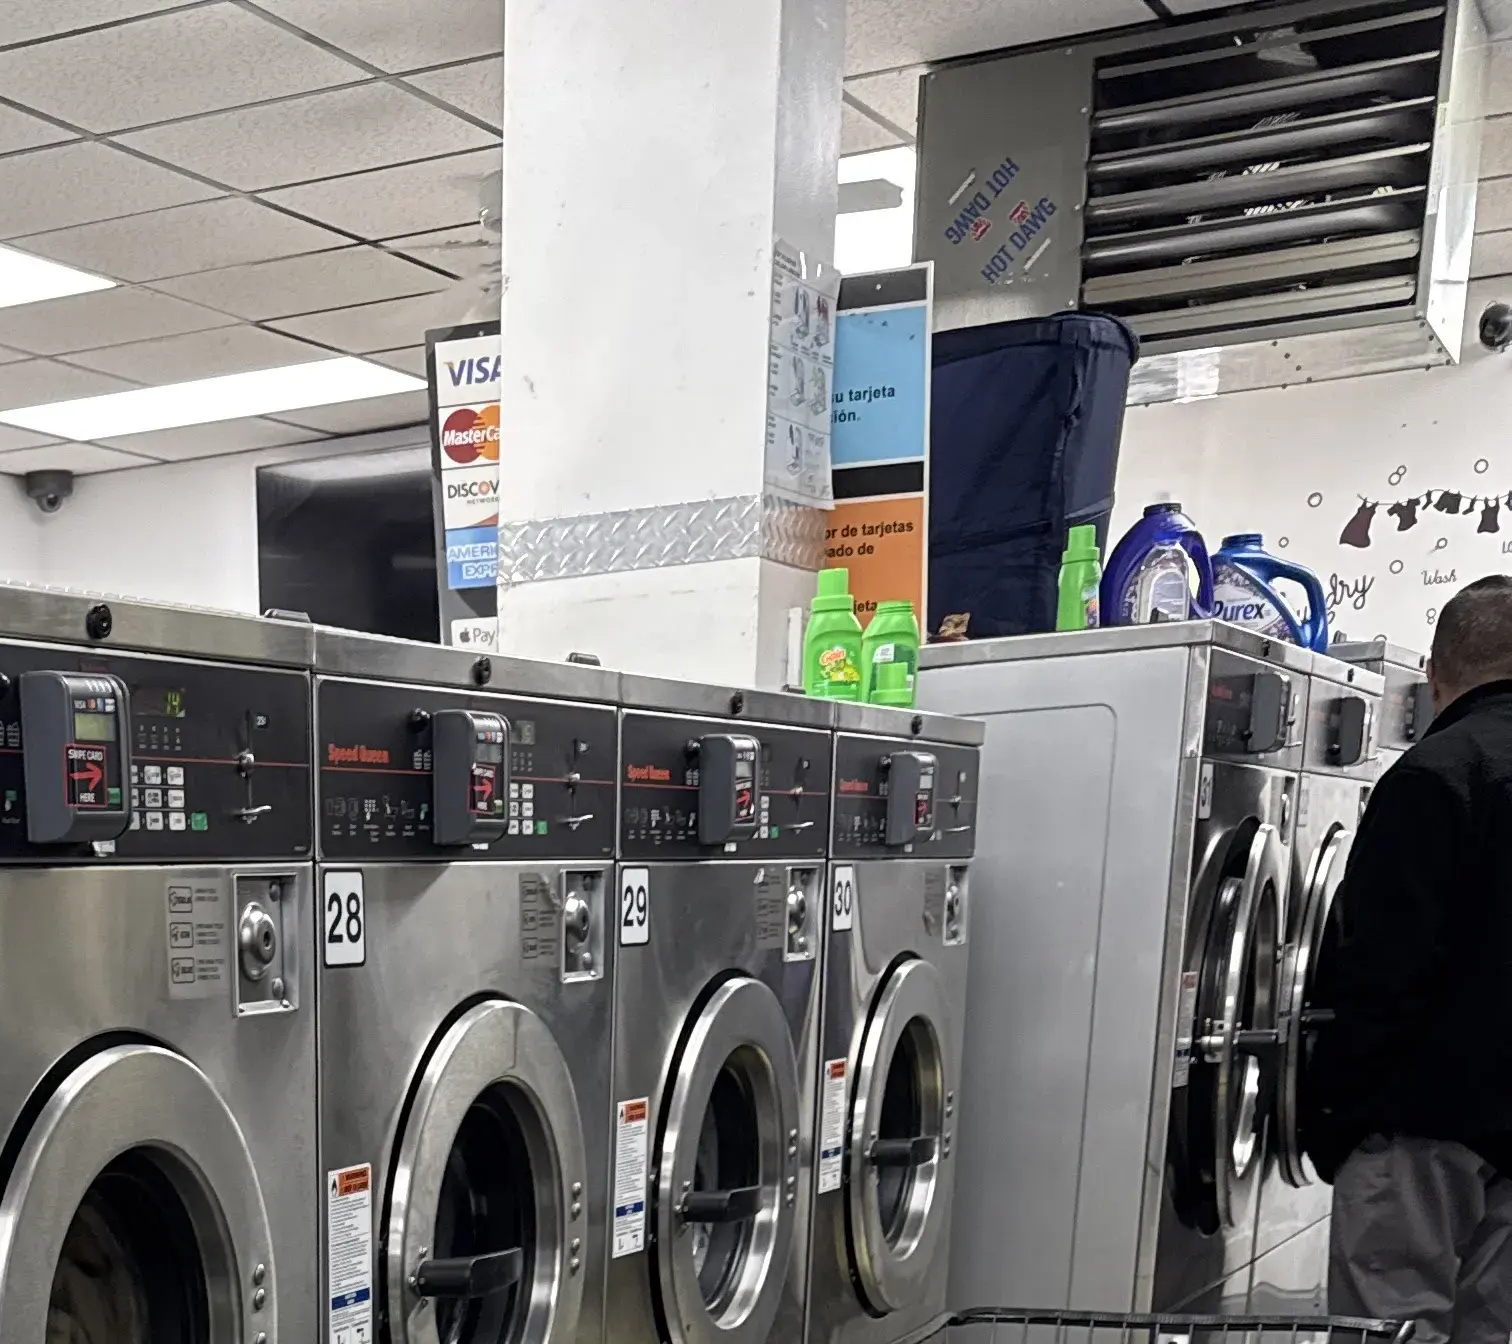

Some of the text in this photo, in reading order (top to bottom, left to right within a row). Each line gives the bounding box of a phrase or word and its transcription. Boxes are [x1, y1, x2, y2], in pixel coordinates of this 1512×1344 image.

[980, 197, 1057, 284] HOT DAWG
[443, 355, 501, 387] VISA
[849, 385, 896, 403] tarjeta
[831, 409, 861, 424] ión.
[443, 425, 500, 447] MasterCa
[447, 480, 500, 499] DISCOV
[841, 524, 857, 538] de
[862, 520, 913, 539] tarjetas
[448, 545, 498, 560] AMERI
[858, 542, 874, 555] de
[1421, 568, 1457, 586] Wash
[473, 627, 496, 646] Pay
[623, 885, 647, 927] 29
[834, 880, 851, 917] 30
[327, 892, 362, 943] 28
